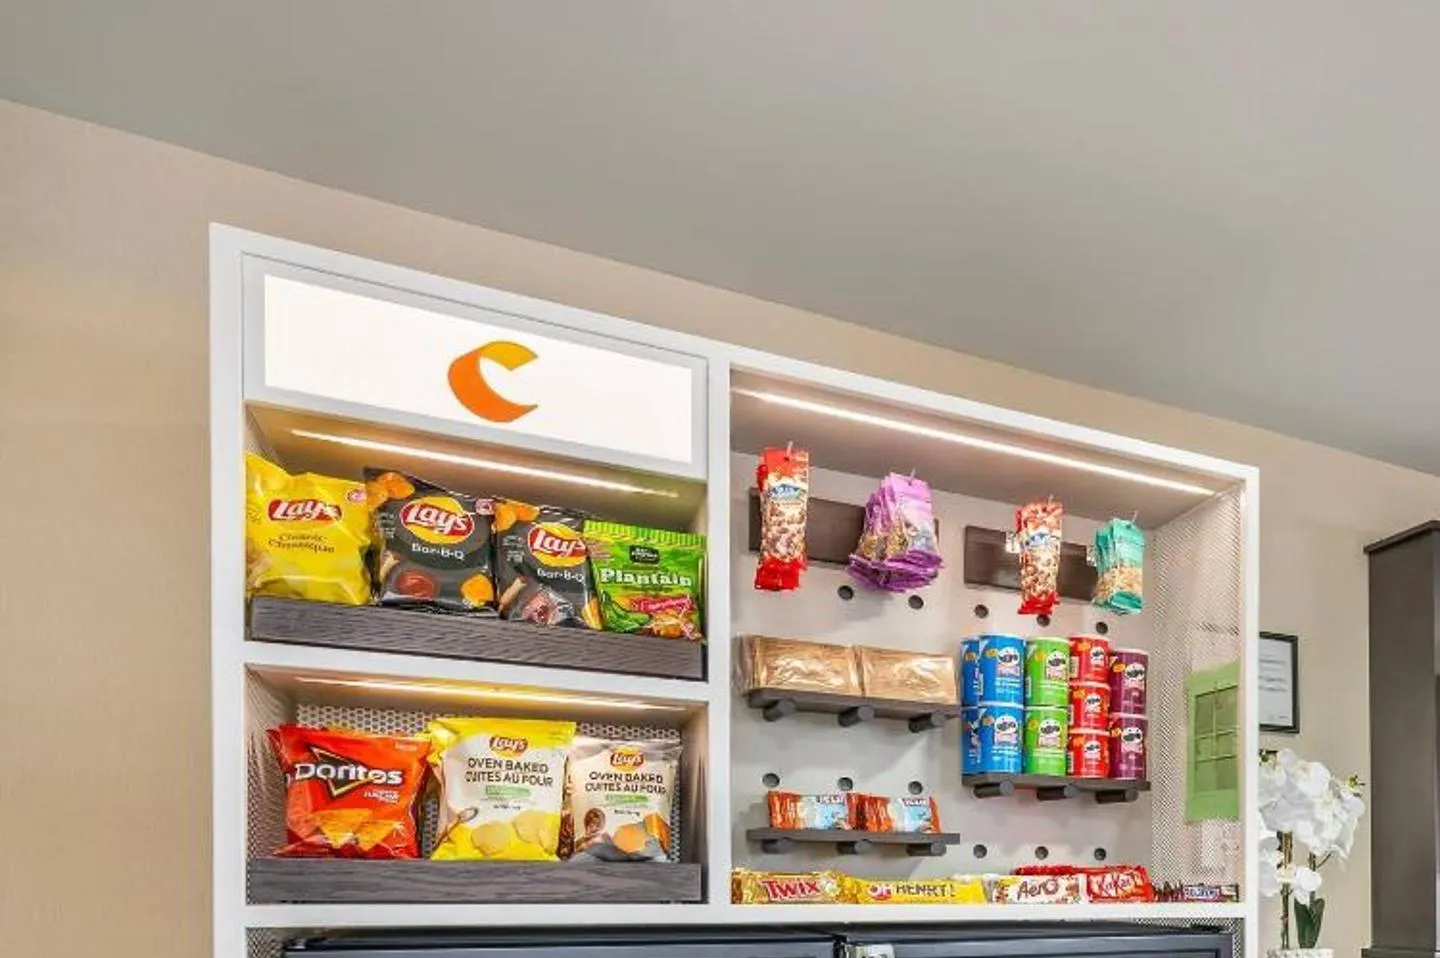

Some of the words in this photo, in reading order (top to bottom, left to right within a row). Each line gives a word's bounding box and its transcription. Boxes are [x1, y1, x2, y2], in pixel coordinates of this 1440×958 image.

[294, 763, 404, 785] Doritos
[467, 757, 503, 769] OVEN
[505, 760, 549, 774] BAKED
[503, 773, 520, 784] AU
[522, 775, 554, 787] FOUR
